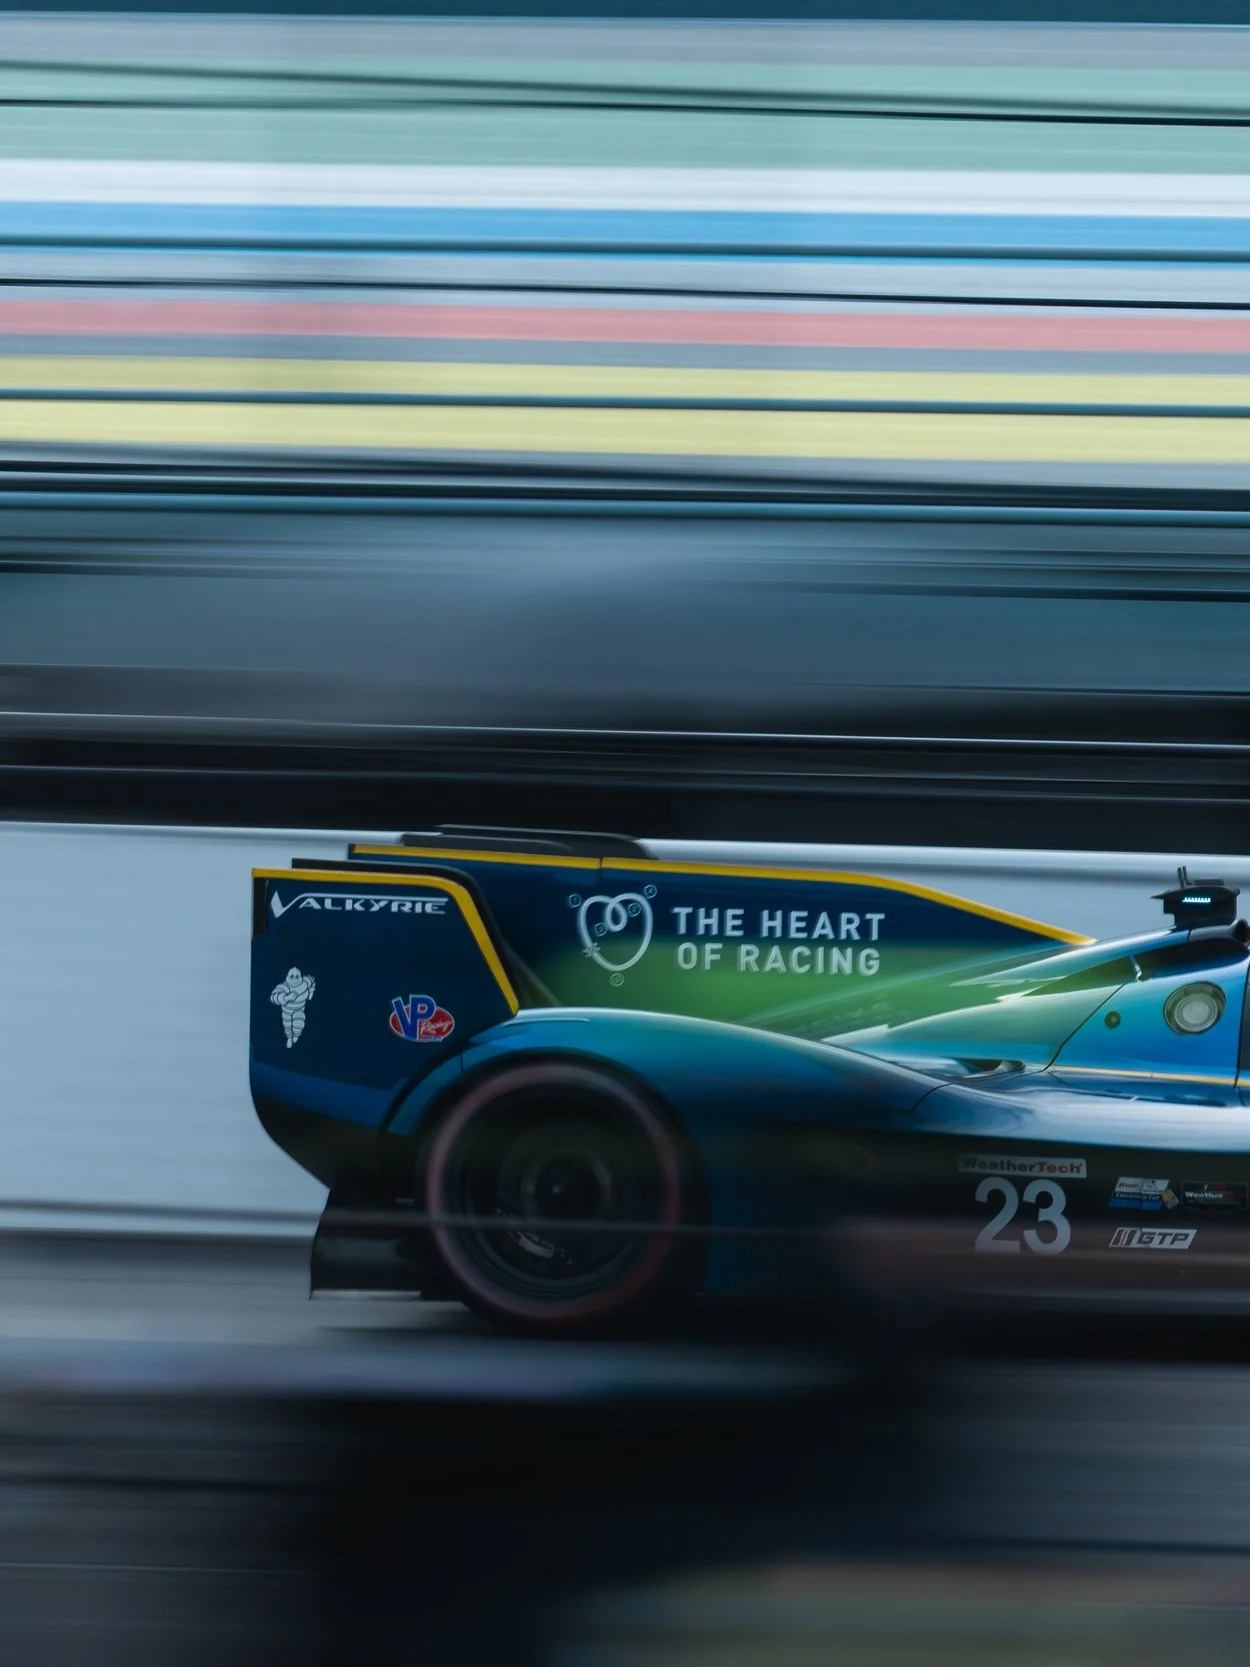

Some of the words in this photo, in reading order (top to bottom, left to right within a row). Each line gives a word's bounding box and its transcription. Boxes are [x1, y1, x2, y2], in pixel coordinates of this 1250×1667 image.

[270, 890, 449, 918] VALKYRIE
[671, 907, 744, 937] THE
[760, 909, 885, 941] HEART
[675, 942, 723, 970] OF
[738, 943, 881, 977] RACING
[391, 994, 437, 1041] VP
[963, 1157, 1083, 1175] WeatherTech
[974, 1176, 1072, 1256] 23
[1137, 1232, 1191, 1246] GTP
